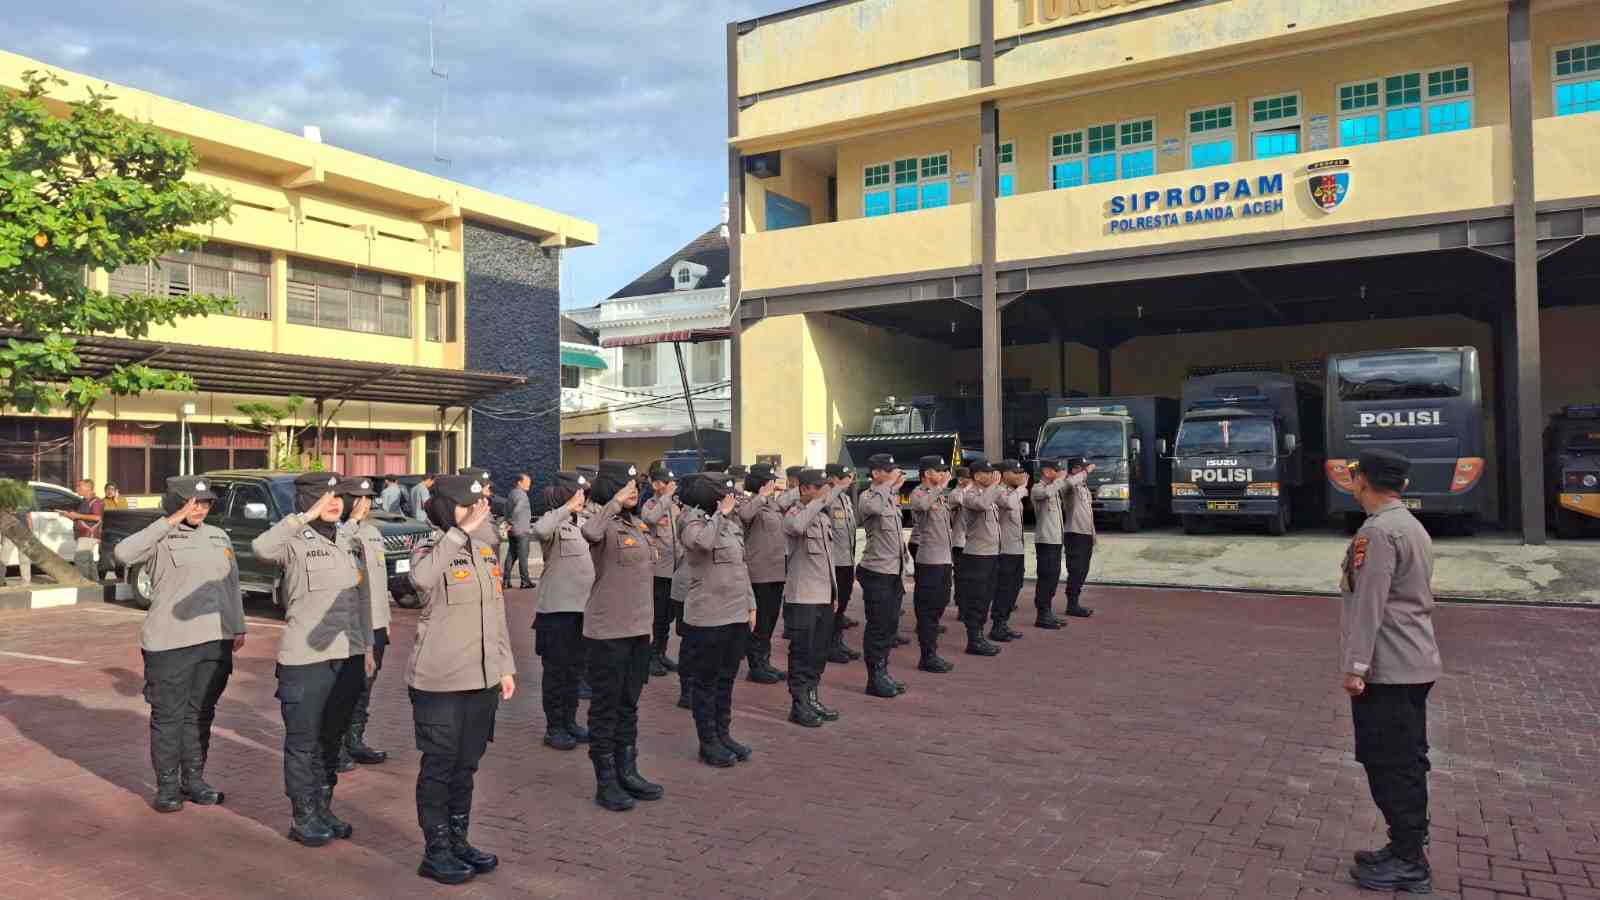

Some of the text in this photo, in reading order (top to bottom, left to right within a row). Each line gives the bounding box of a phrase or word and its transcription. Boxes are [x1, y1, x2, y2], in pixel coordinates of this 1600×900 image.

[1110, 173, 1284, 216] SIPROPAM
[1110, 198, 1284, 233] POLRESTA BANDA ACEH
[1360, 410, 1441, 428] POLISI
[1206, 459, 1238, 467] ISUZU
[1191, 468, 1253, 483] POLISI
